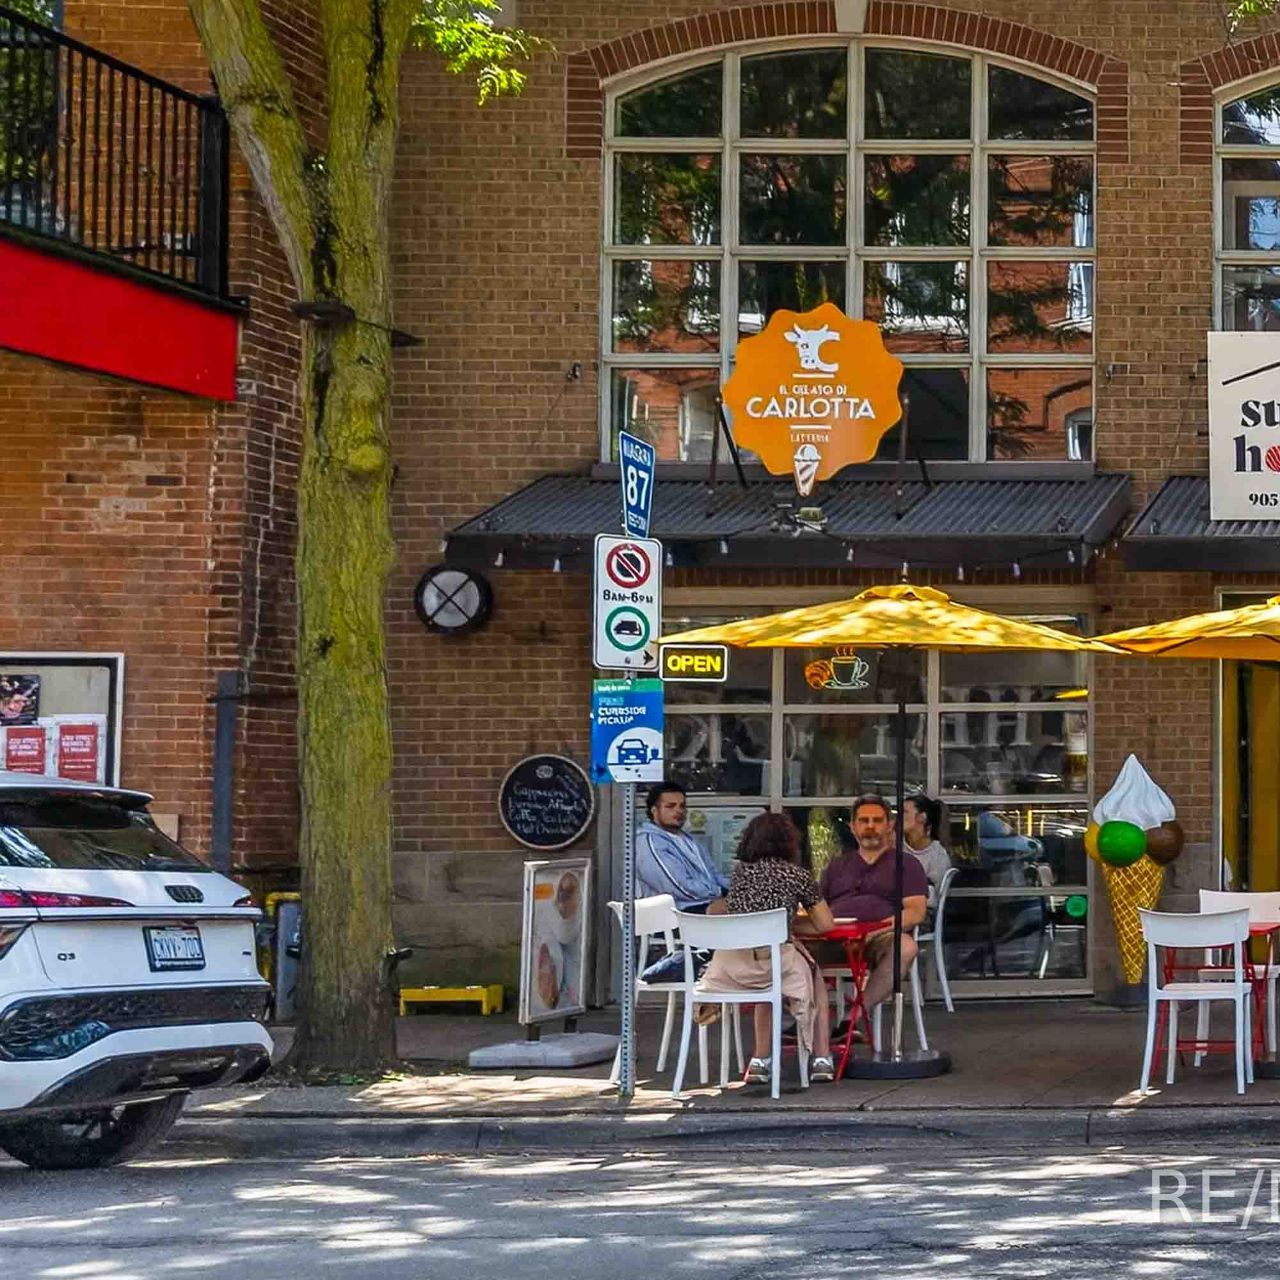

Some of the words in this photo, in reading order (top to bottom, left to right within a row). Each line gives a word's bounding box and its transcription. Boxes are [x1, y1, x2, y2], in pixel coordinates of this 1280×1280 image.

[746, 396, 876, 419] CARLOTTA
[627, 464, 650, 511] 87
[667, 655, 721, 672] OPEN
[57, 952, 76, 961] Q3
